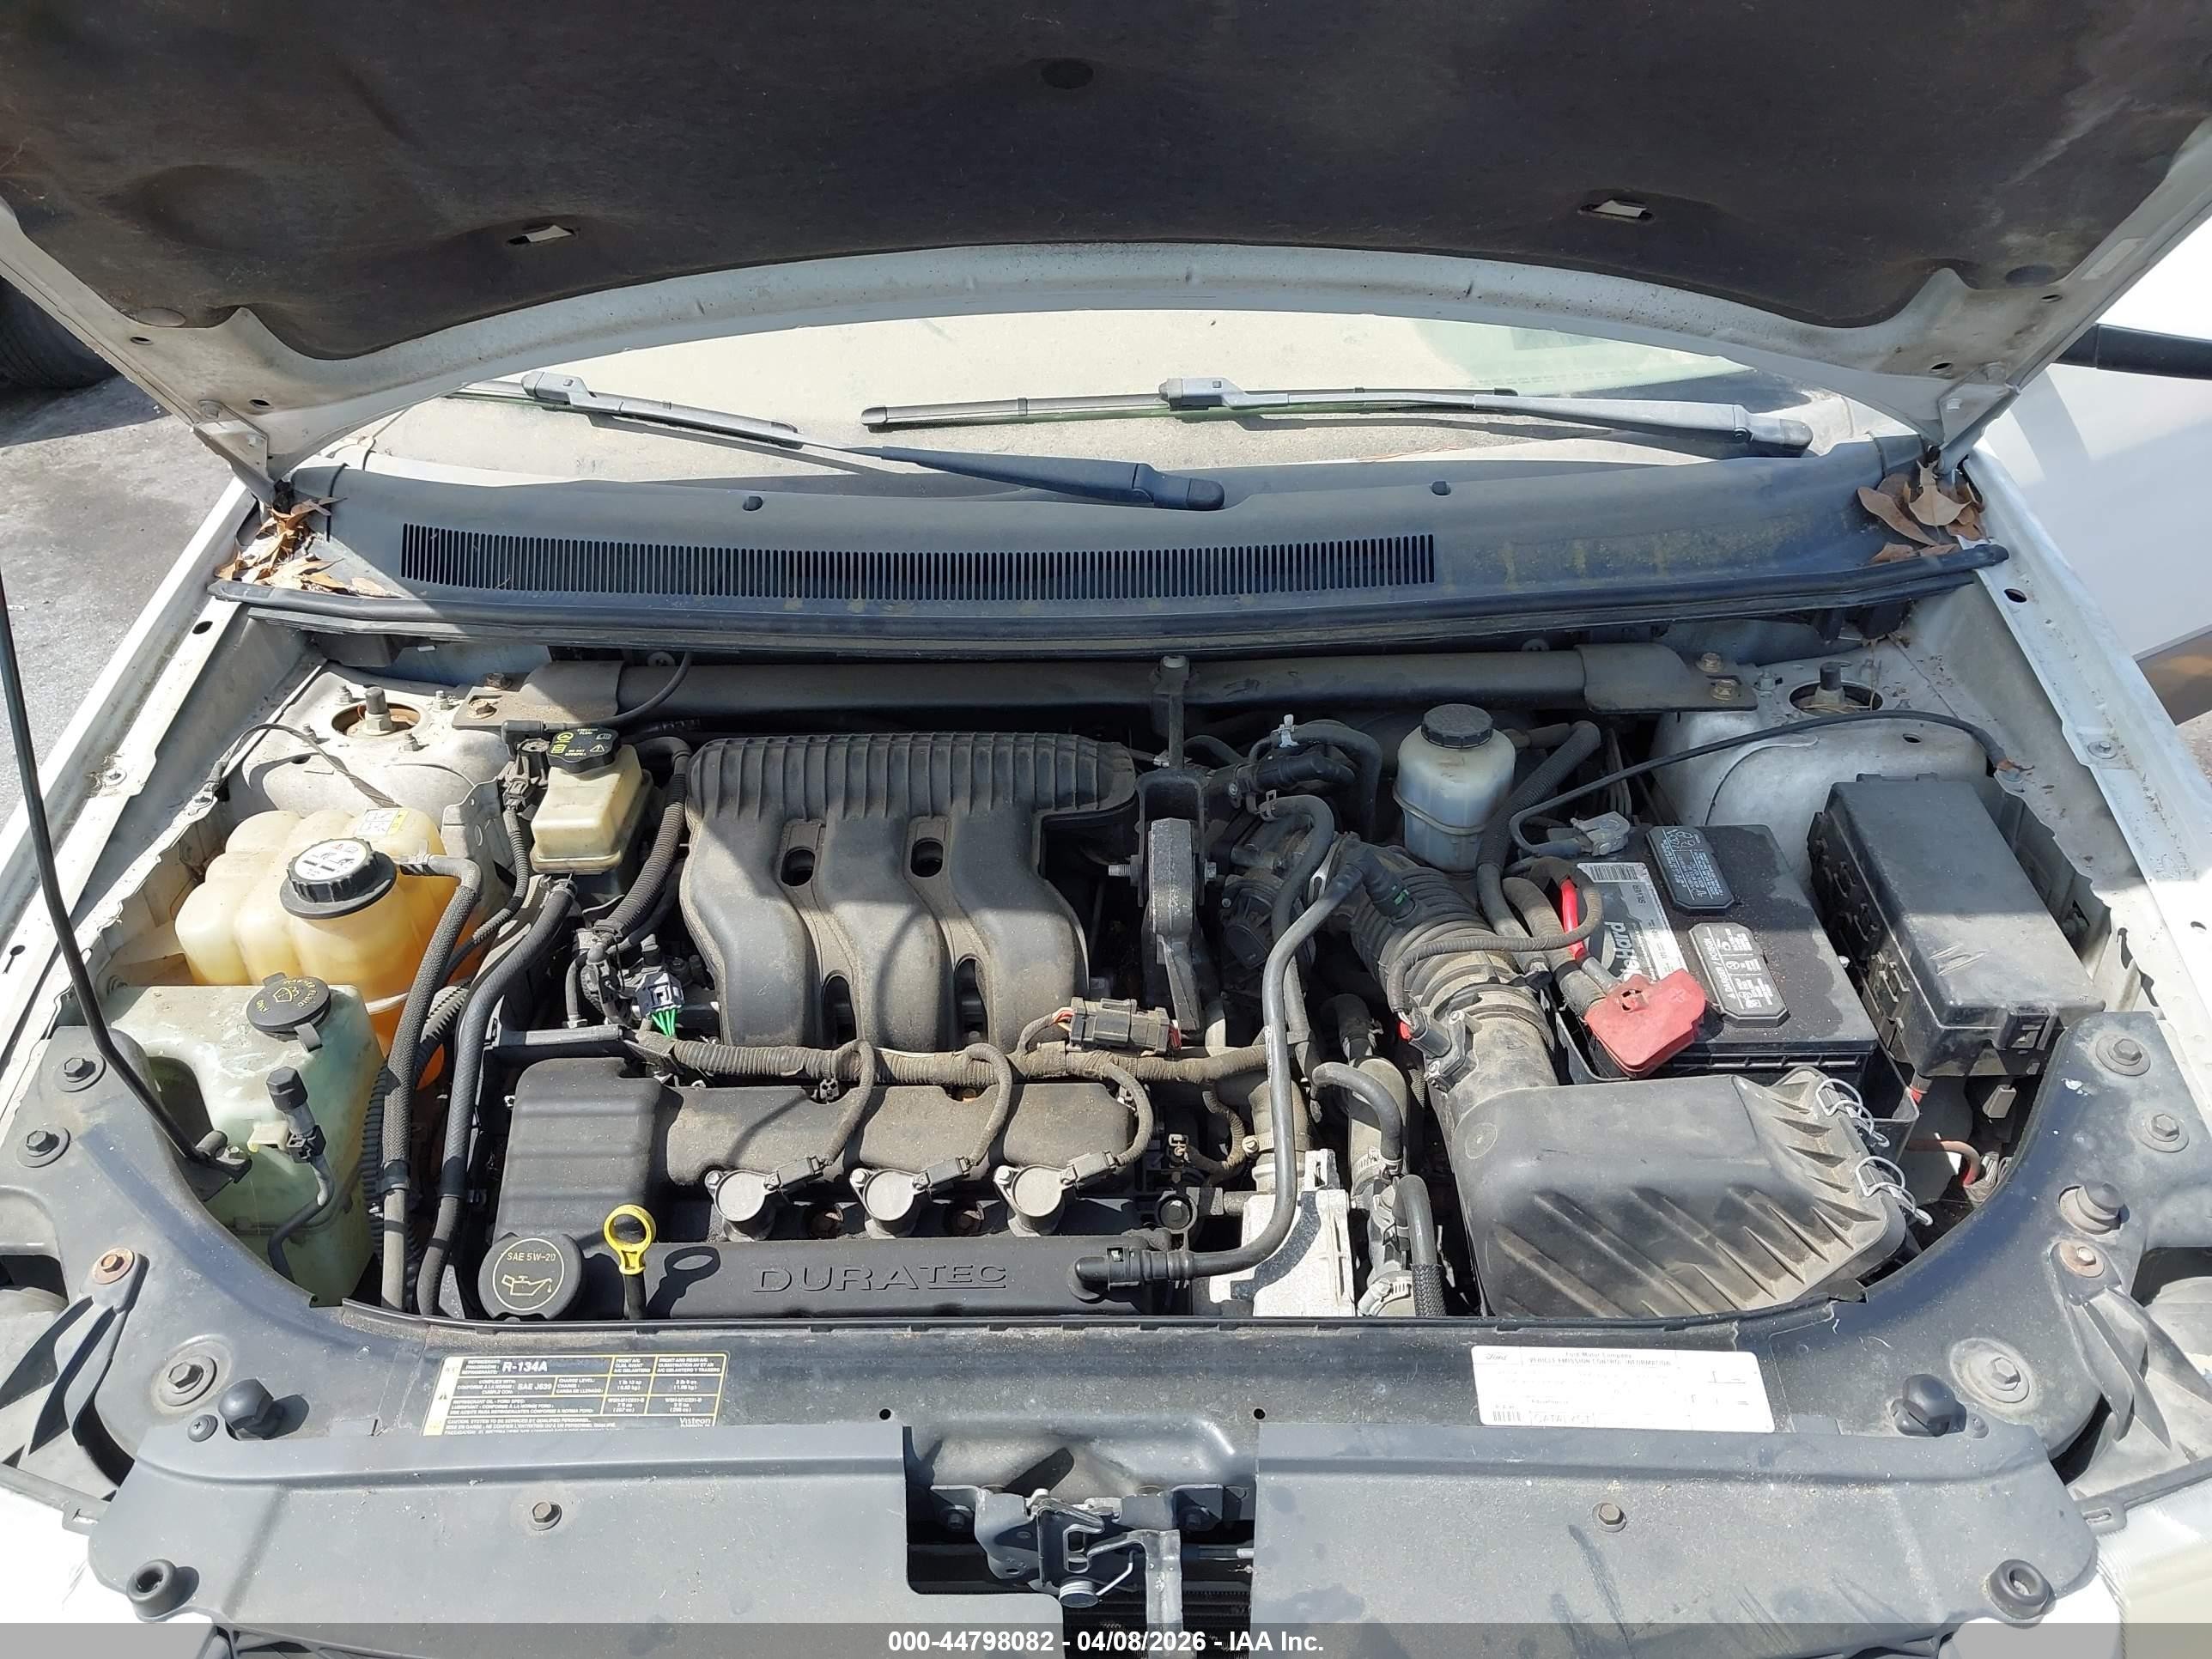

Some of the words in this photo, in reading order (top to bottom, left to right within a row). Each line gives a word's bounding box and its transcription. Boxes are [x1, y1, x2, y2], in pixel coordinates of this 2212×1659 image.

[1632, 884, 1647, 904] SILVER
[1703, 938, 1720, 961] POISON
[1716, 967, 1734, 993] DANGER
[297, 989, 317, 1007] FLUID
[507, 1252, 525, 1261] SAE
[526, 1251, 556, 1261] 5W-20
[751, 1264, 1007, 1292] DURATEC
[501, 1360, 548, 1372] R-134A
[1486, 1352, 1509, 1361] Ford
